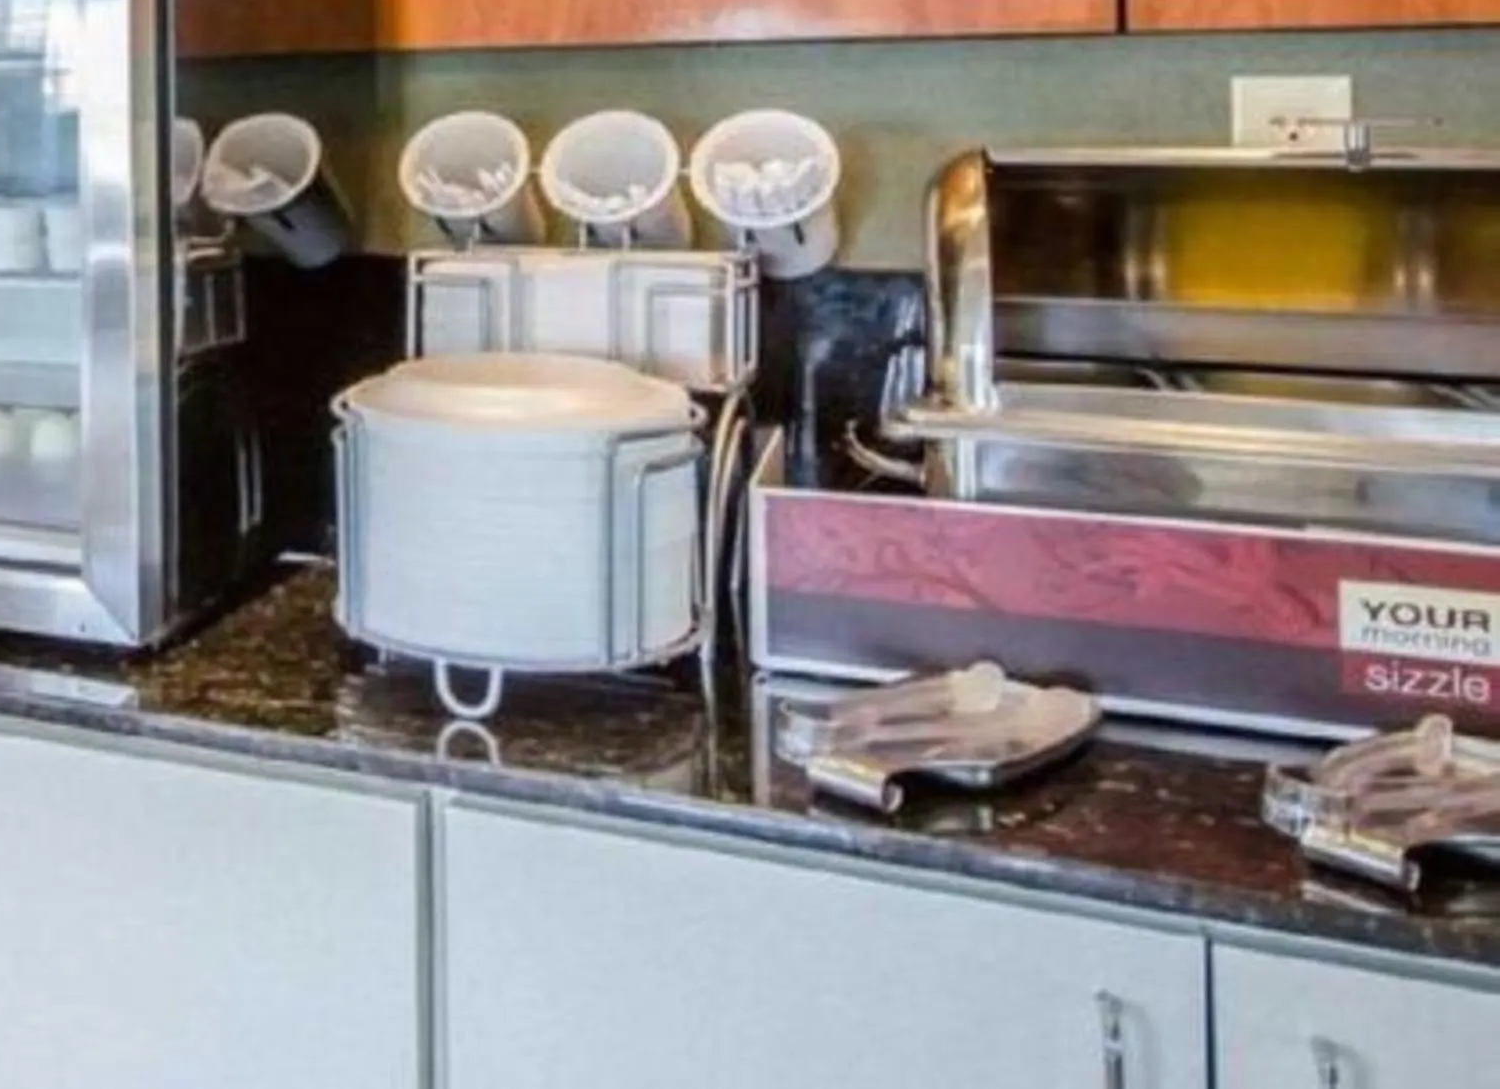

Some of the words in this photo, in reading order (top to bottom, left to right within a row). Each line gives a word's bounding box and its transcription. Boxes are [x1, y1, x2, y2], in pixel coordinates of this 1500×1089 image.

[1361, 598, 1491, 633] YOUR
[1361, 626, 1492, 657] morning
[1365, 661, 1492, 703] sizzle
